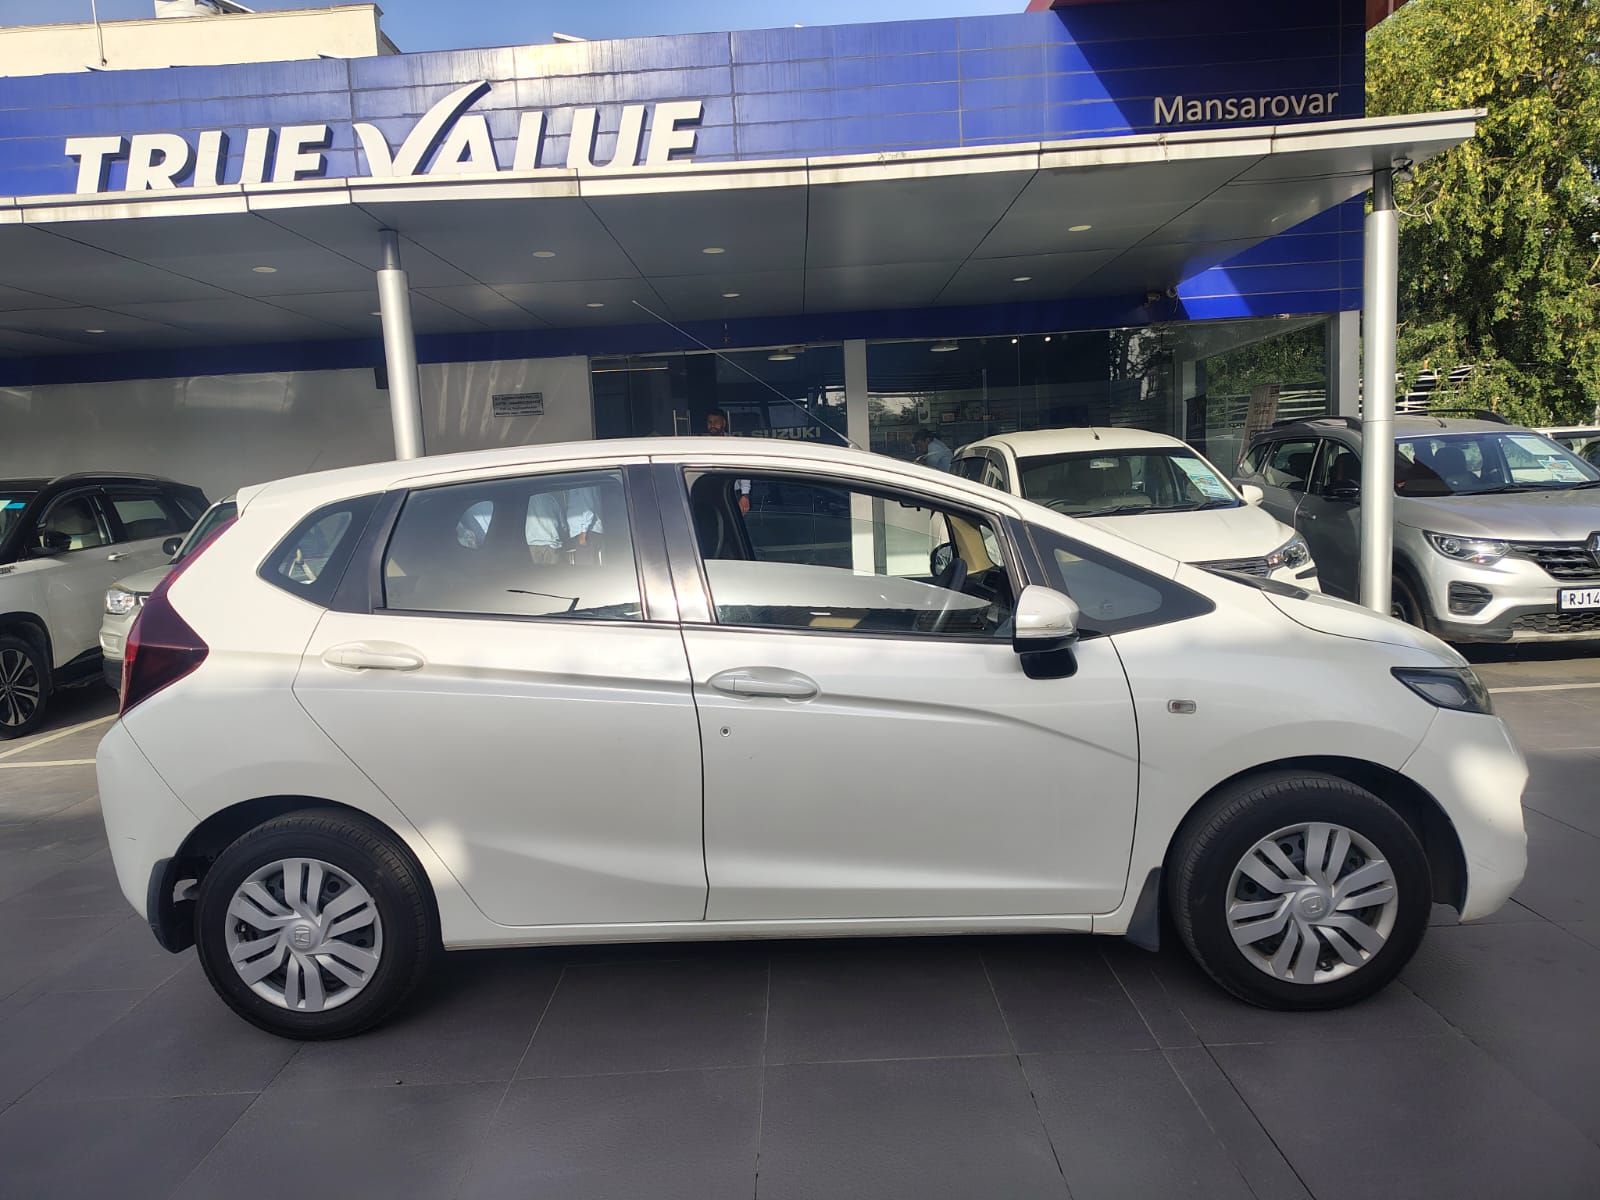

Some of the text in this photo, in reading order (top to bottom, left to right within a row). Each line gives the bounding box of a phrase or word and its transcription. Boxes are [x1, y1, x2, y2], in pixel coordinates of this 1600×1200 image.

[1154, 92, 1339, 125] Mansarovar
[65, 80, 702, 194] TRUE VALUE
[1569, 592, 1600, 605] RJ14
